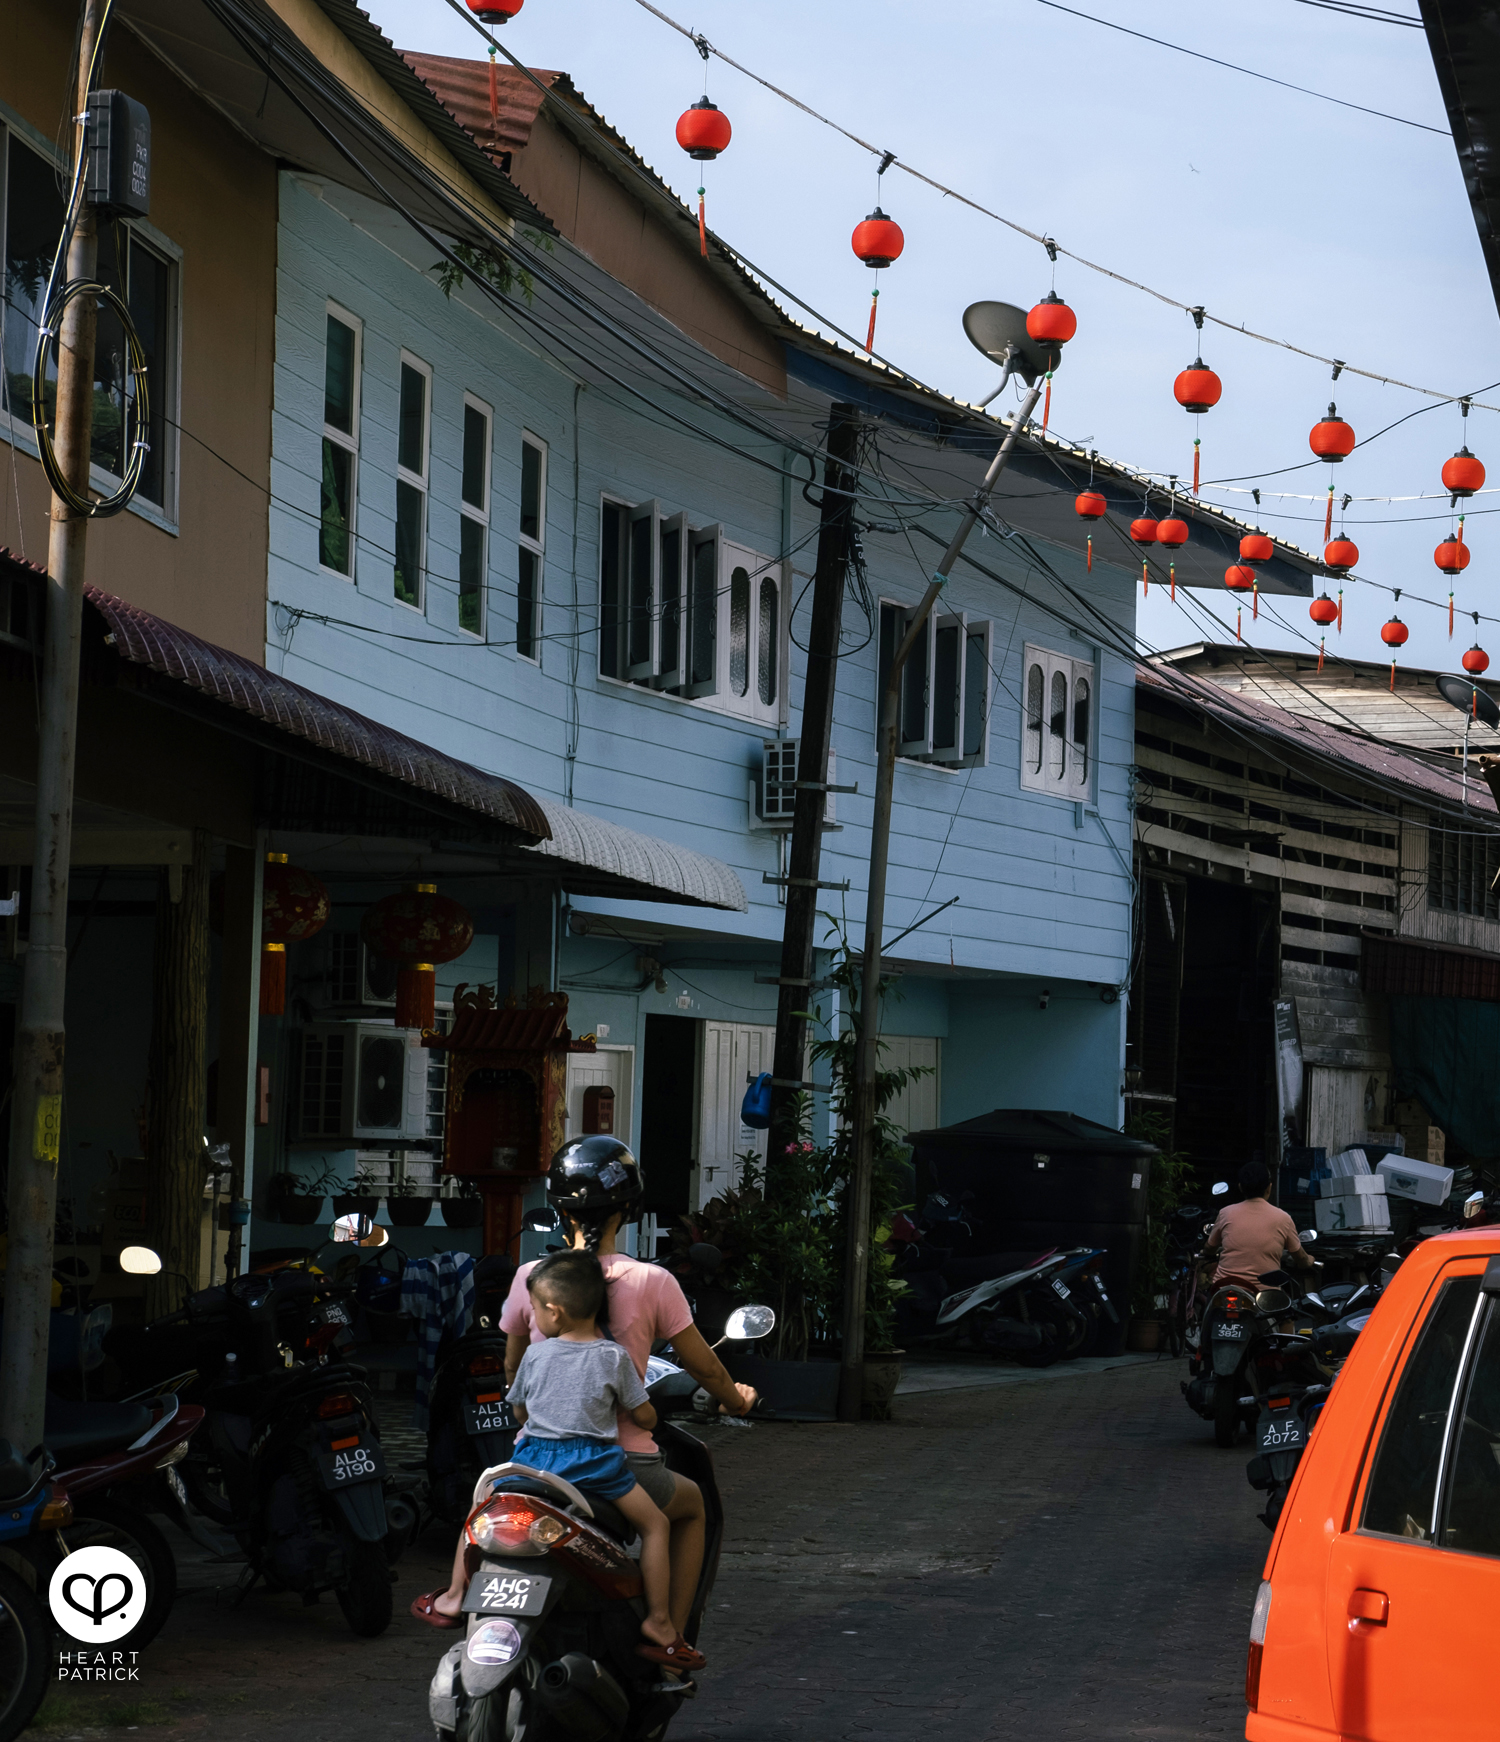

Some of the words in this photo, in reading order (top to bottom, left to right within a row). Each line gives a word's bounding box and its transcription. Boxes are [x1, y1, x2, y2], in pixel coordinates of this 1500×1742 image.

[135, 143, 148, 163] PKR
[1217, 1329, 1242, 1338] 3821
[478, 1401, 504, 1416] ALT
[475, 1415, 509, 1430] 1481
[1267, 1423, 1277, 1435] A
[1285, 1420, 1295, 1432] F
[1262, 1430, 1300, 1446] 2072
[335, 1448, 368, 1468] ALQ
[332, 1459, 376, 1481] 3190
[484, 1577, 531, 1594] AHC
[480, 1592, 529, 1609] 7241
